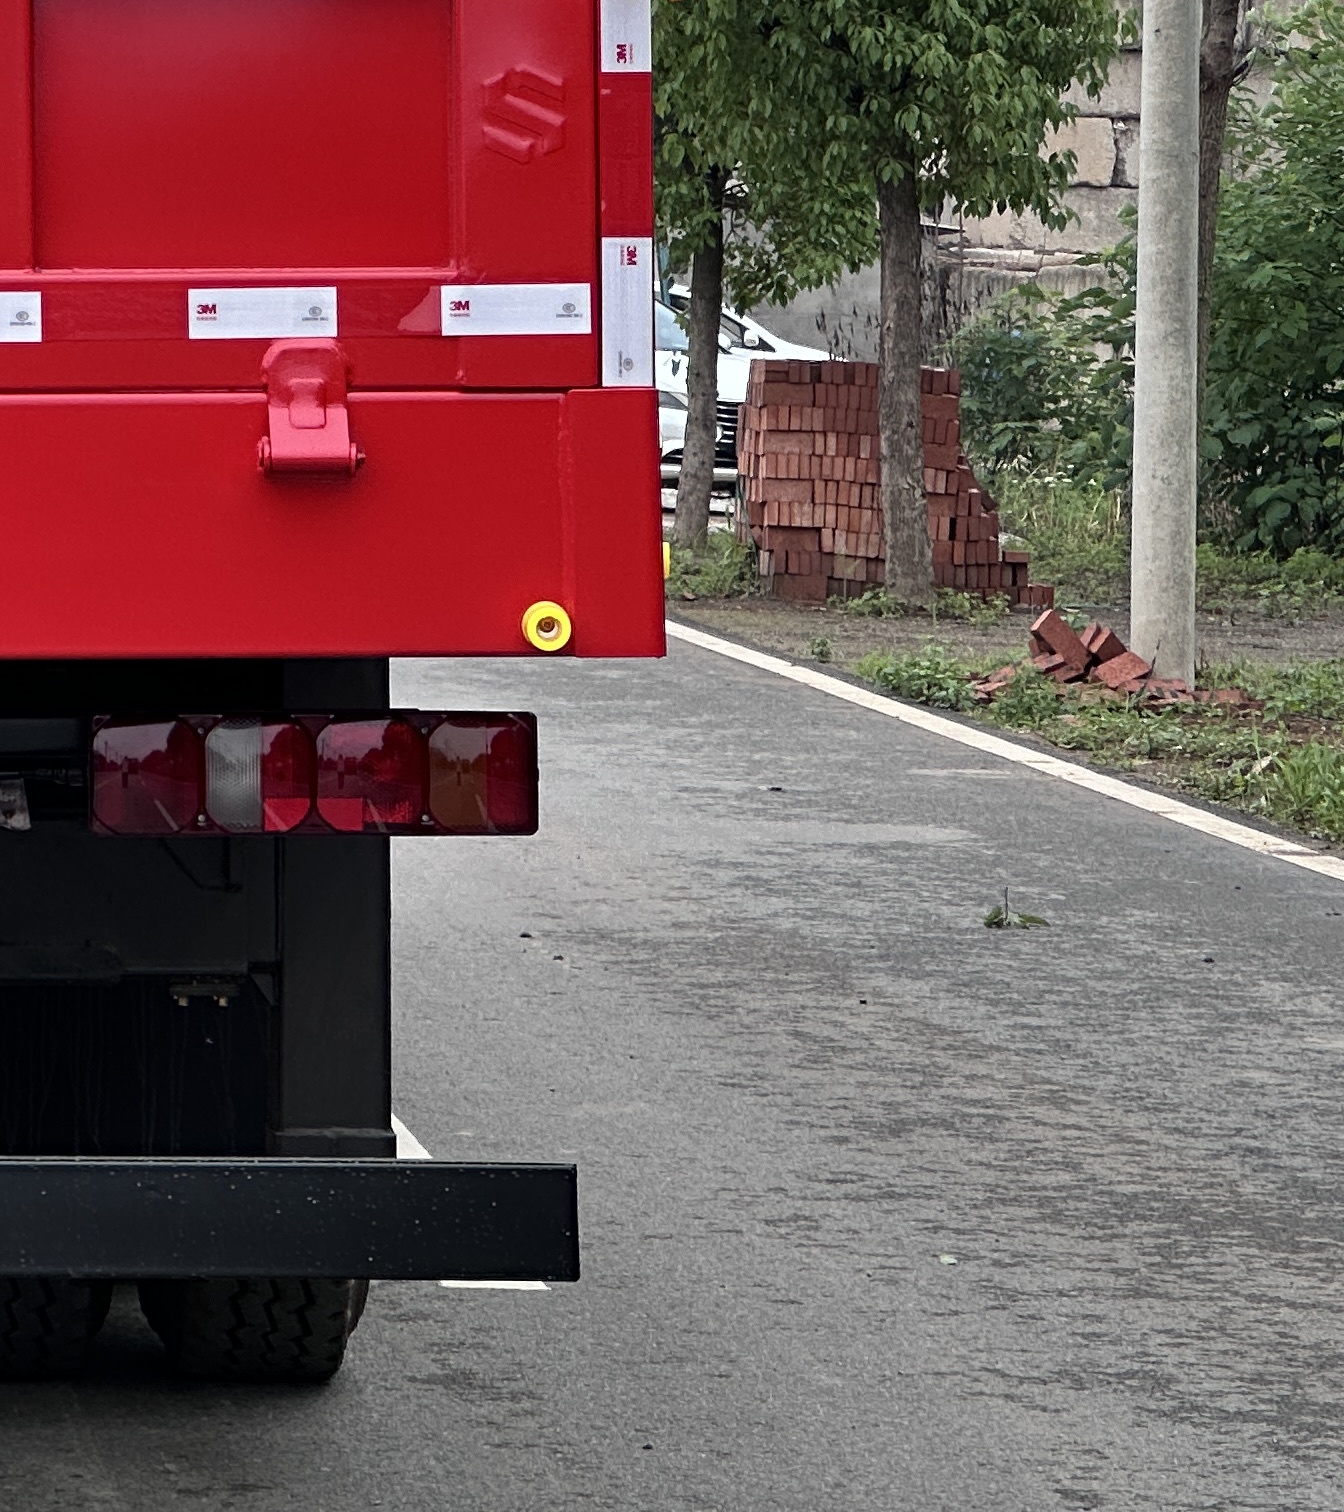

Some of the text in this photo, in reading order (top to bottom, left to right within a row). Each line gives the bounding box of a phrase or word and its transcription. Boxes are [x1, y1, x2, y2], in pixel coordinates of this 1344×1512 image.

[616, 44, 627, 64] 3M
[626, 246, 638, 266] 3M
[196, 304, 217, 315] 3M
[449, 300, 470, 312] 3M
